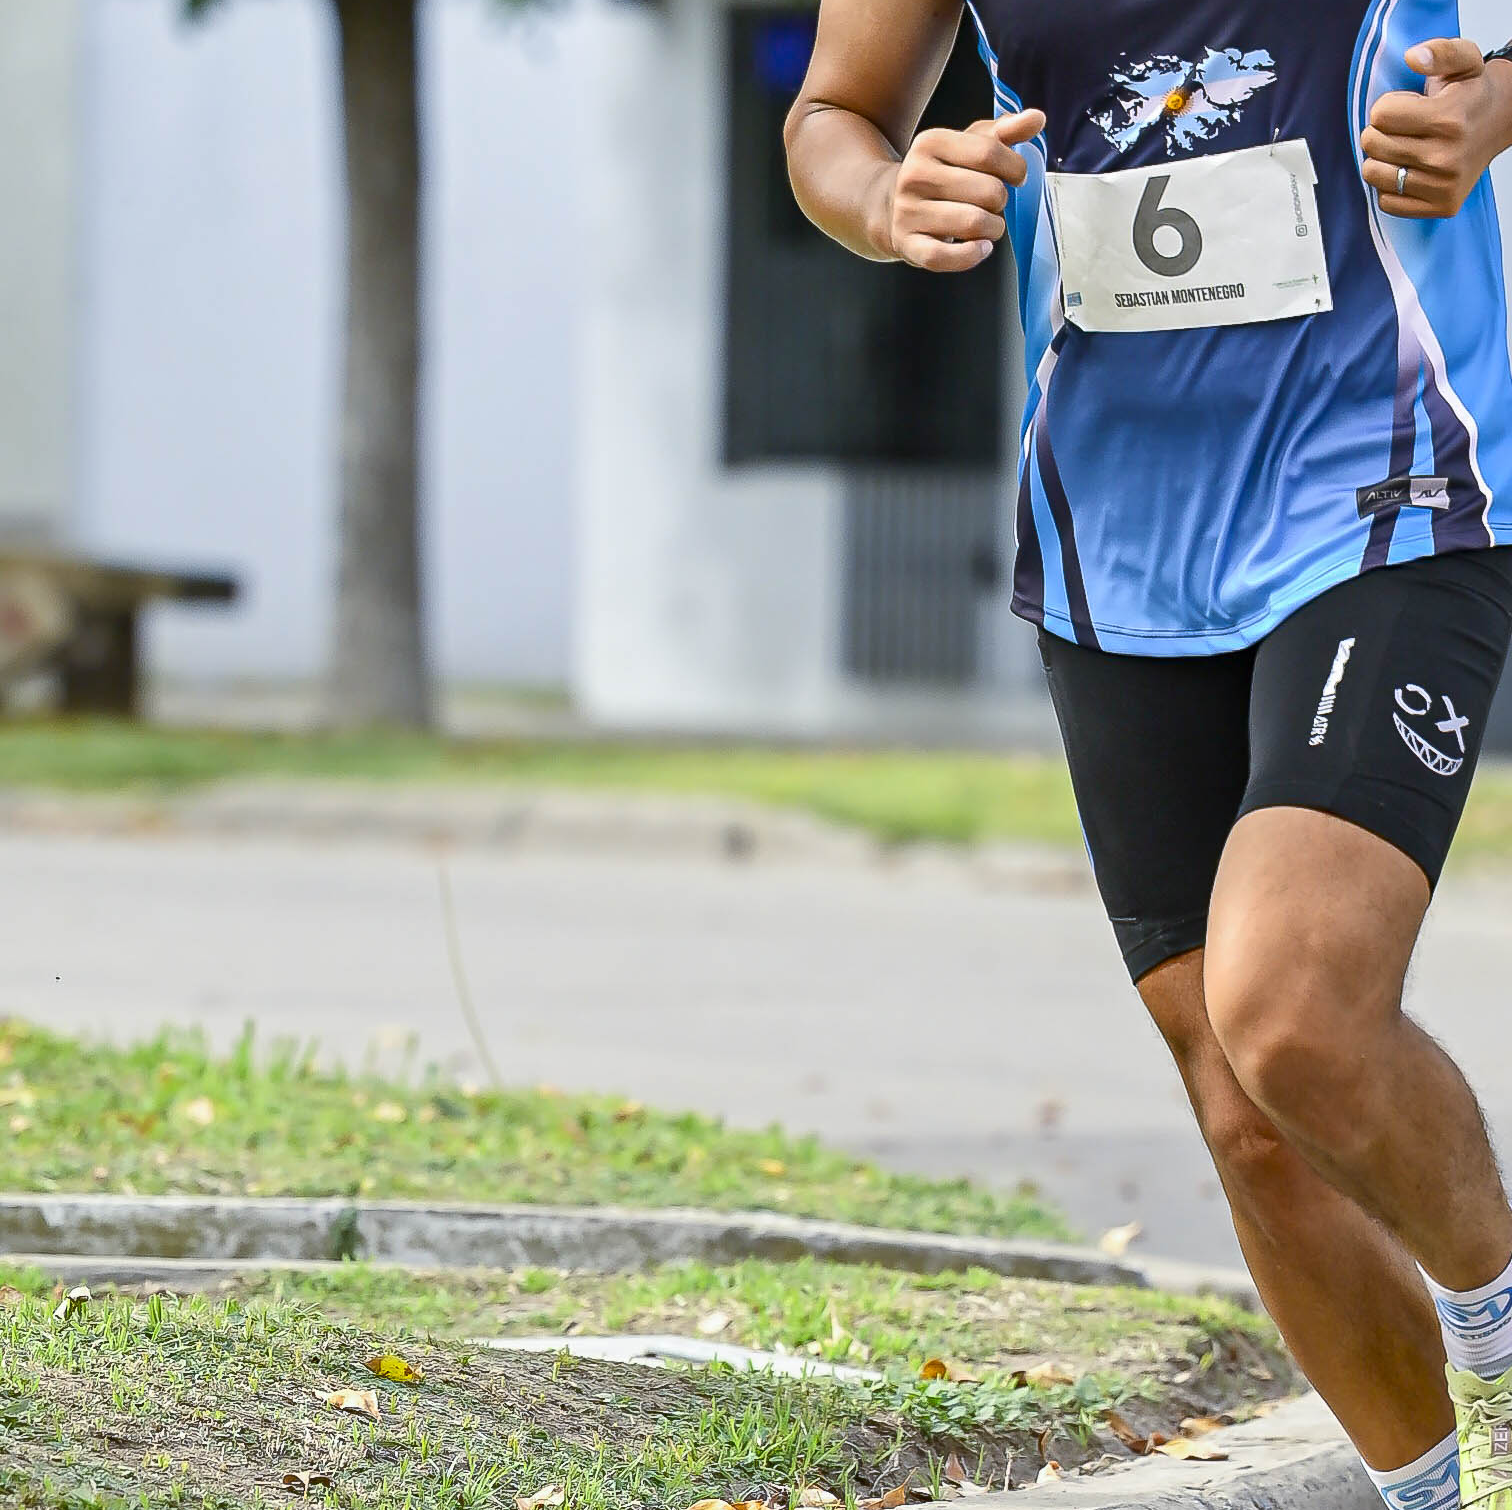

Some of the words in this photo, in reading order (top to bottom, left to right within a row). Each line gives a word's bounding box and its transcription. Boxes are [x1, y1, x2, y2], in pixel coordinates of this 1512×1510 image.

[1132, 174, 1203, 277] 6
[1114, 290, 1170, 308] SEBASTIAN
[1170, 282, 1246, 304] MONTENEGRO
